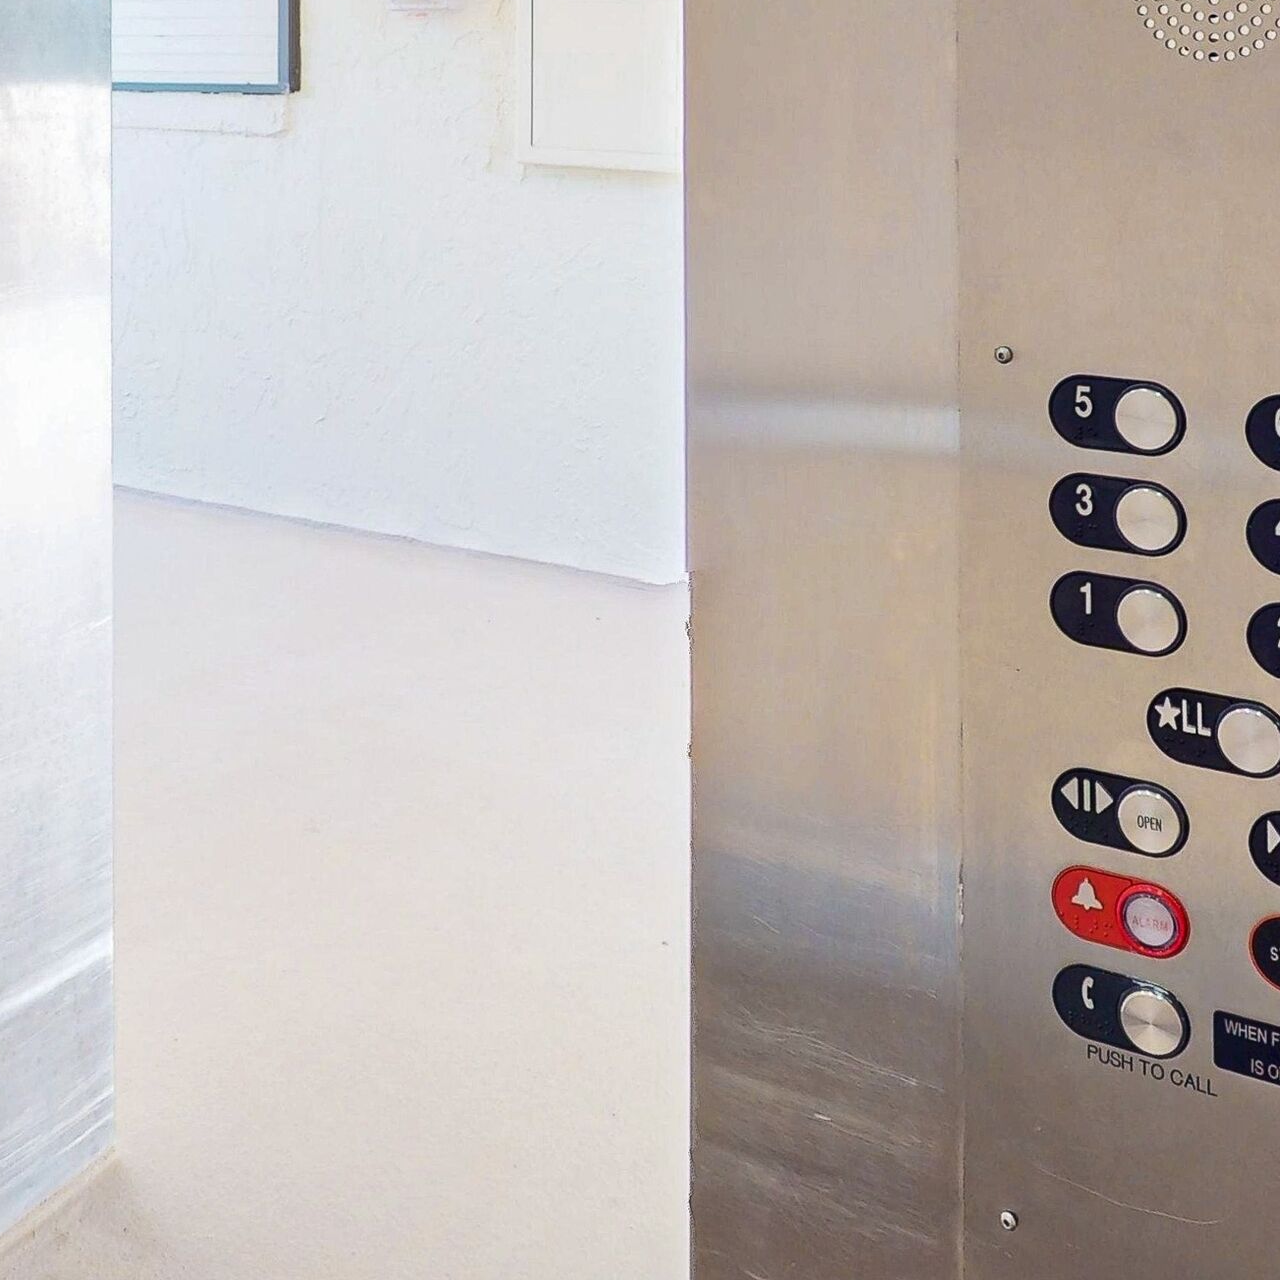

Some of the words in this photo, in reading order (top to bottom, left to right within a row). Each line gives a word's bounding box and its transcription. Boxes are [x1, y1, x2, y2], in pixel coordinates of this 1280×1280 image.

[1074, 385, 1093, 418] 5
[1075, 483, 1093, 516] 3
[1080, 582, 1092, 615] 1
[1137, 806, 1162, 832] OPEN
[1224, 1019, 1268, 1045] WHEN
[1087, 1044, 1134, 1072] PUSH
[1139, 1061, 1165, 1080] TO
[1170, 1069, 1218, 1098] CALL
[1250, 1057, 1265, 1074] IS
